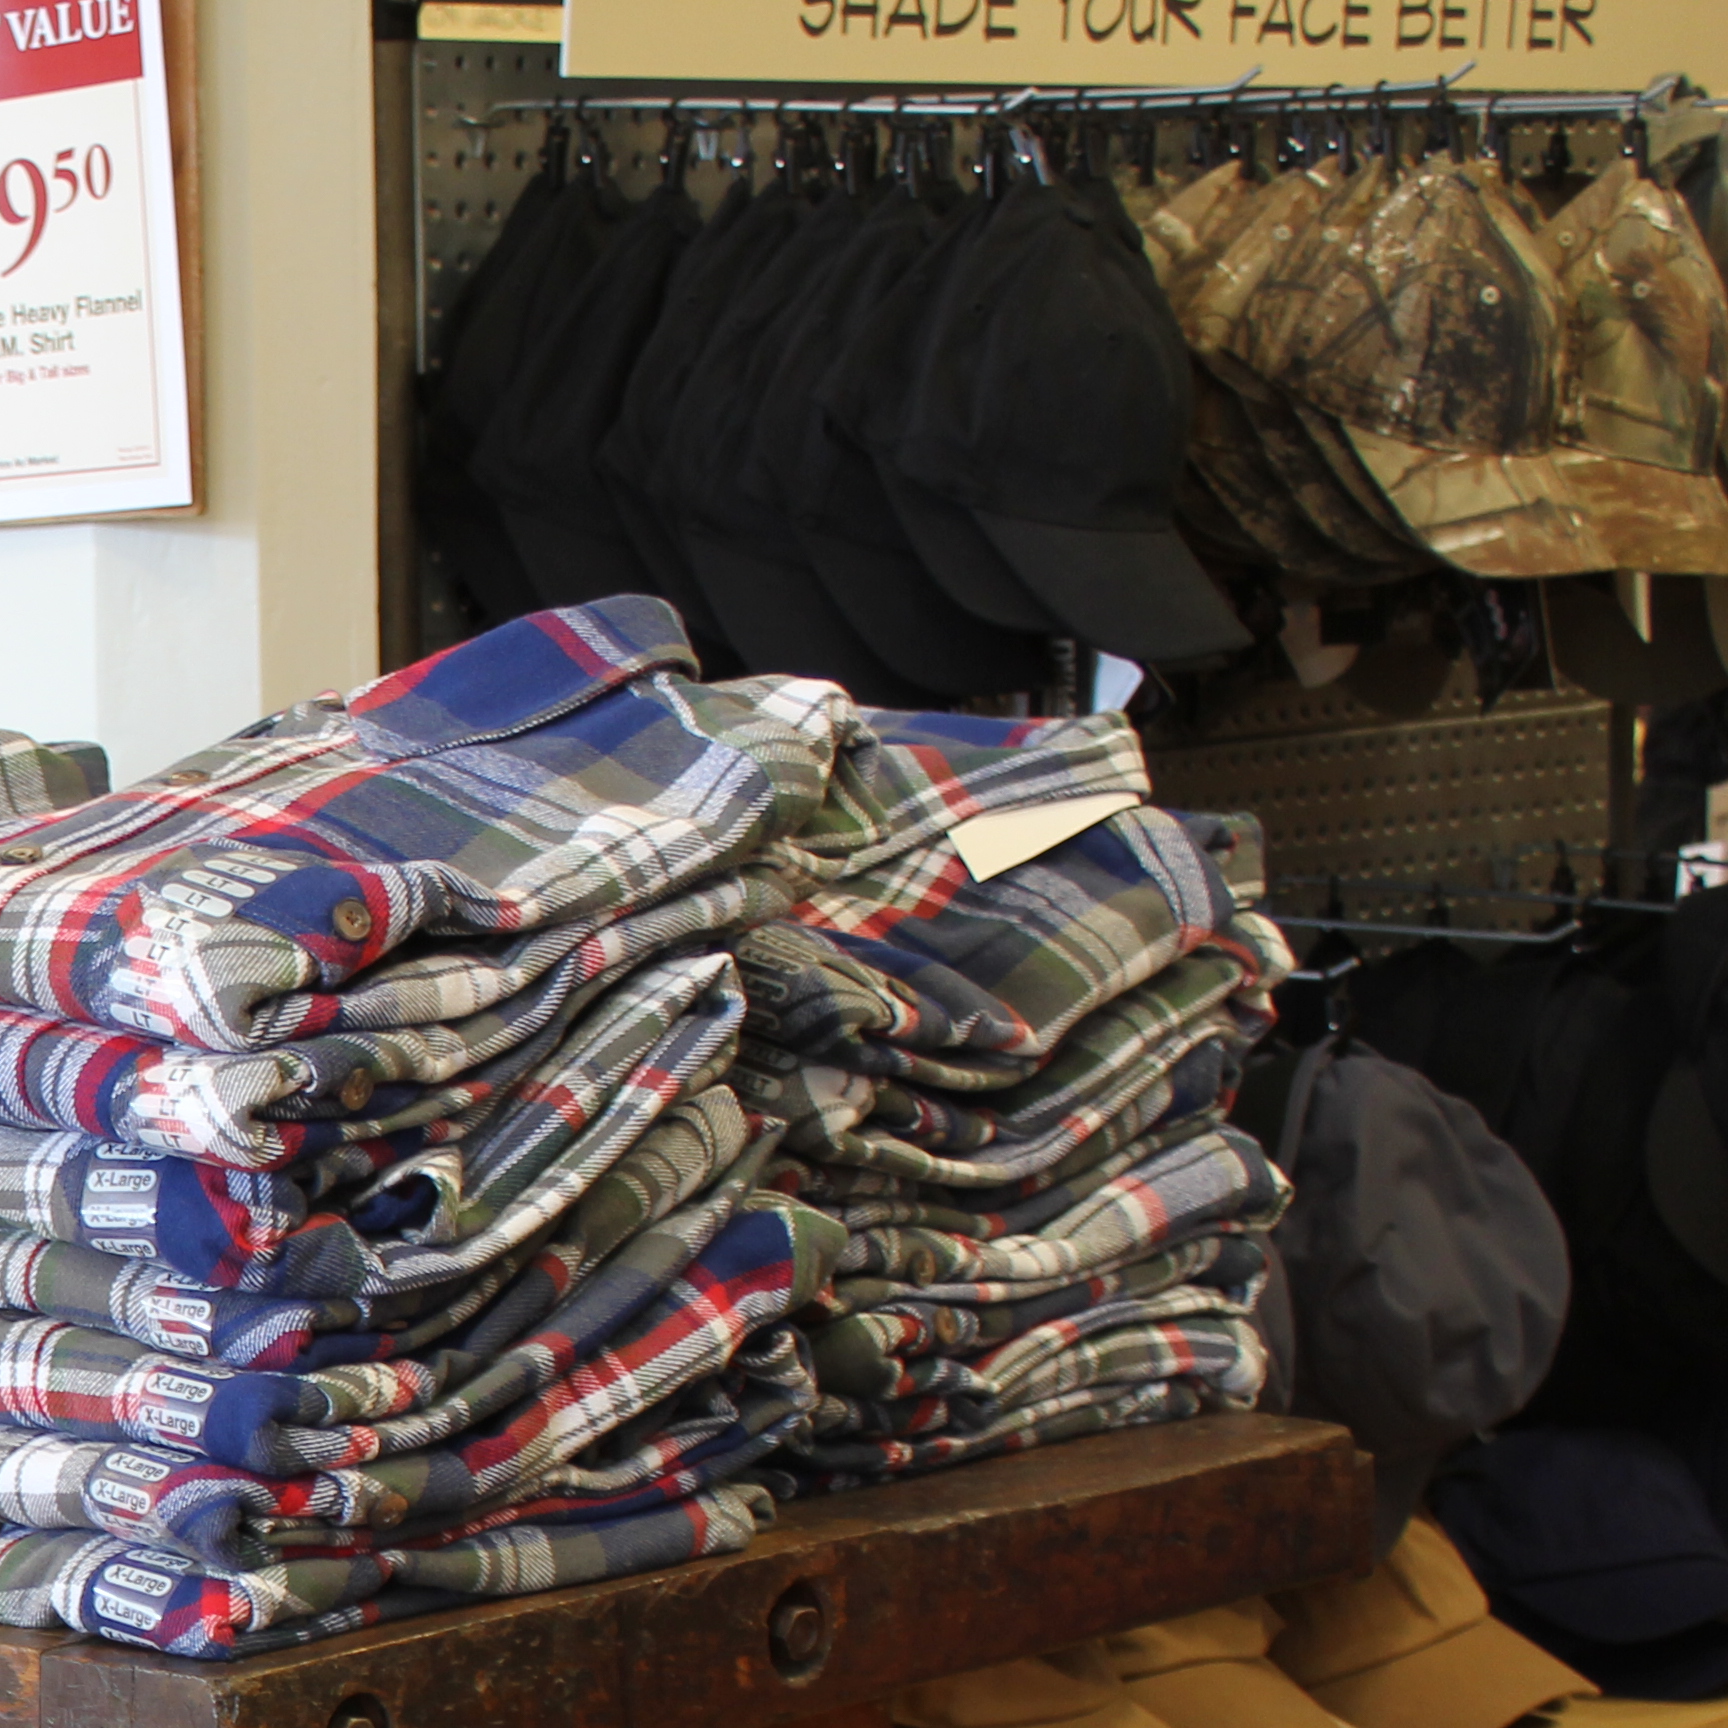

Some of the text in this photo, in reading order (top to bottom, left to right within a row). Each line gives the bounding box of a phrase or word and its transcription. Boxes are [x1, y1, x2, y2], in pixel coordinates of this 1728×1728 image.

[4, 0, 136, 53] VALUE
[10, 301, 70, 326] Heavy
[74, 288, 144, 319] Flannel
[29, 330, 76, 356] Shirt
[206, 876, 233, 889] LT
[184, 891, 211, 908] LT
[163, 916, 191, 933] LT
[146, 942, 172, 962] LT
[132, 1010, 152, 1029] LT
[167, 1067, 193, 1083] LT
[158, 1097, 181, 1118] LT
[161, 1132, 182, 1149] LT
[93, 1171, 152, 1191] X-Large
[95, 1239, 153, 1258] X-Large
[153, 1331, 206, 1355] X-Large
[150, 1373, 208, 1401] X-Large
[144, 1407, 196, 1436] X-Large
[110, 1453, 164, 1479] X-Large
[96, 1479, 147, 1511] X-Large
[109, 1565, 168, 1593] X-Large
[100, 1597, 154, 1628] X-Large
